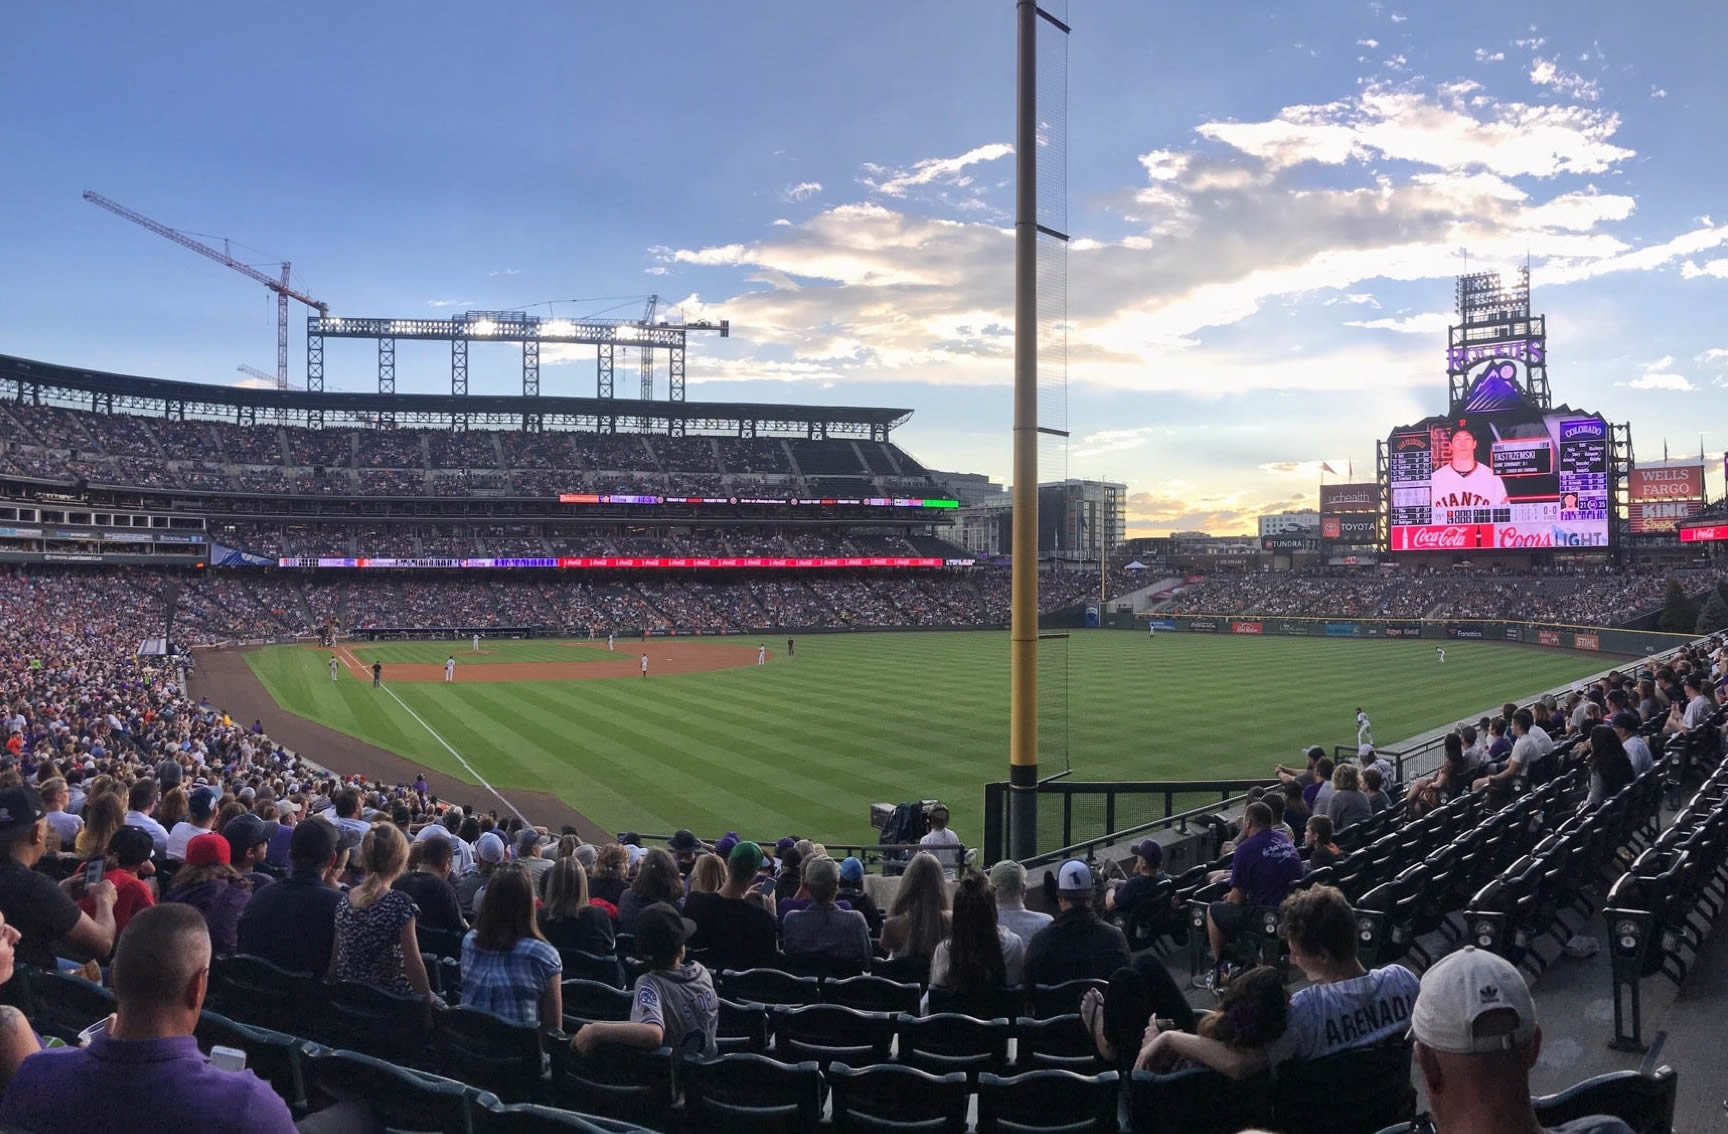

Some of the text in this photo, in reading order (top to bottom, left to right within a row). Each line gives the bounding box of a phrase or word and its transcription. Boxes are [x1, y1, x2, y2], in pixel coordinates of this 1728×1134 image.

[1641, 469, 1689, 481] WELLS
[1643, 483, 1690, 495] FARGO
[1329, 491, 1370, 503] uchealth
[1641, 503, 1688, 518] KING
[1341, 523, 1376, 531] TOYOTA
[1414, 527, 1468, 547] Coca-Cola
[1499, 527, 1602, 547] Coors LIGHT
[1273, 540, 1302, 548] TUNDRA
[1575, 637, 1596, 648] STIHL
[1326, 994, 1412, 1046] ARENAD
